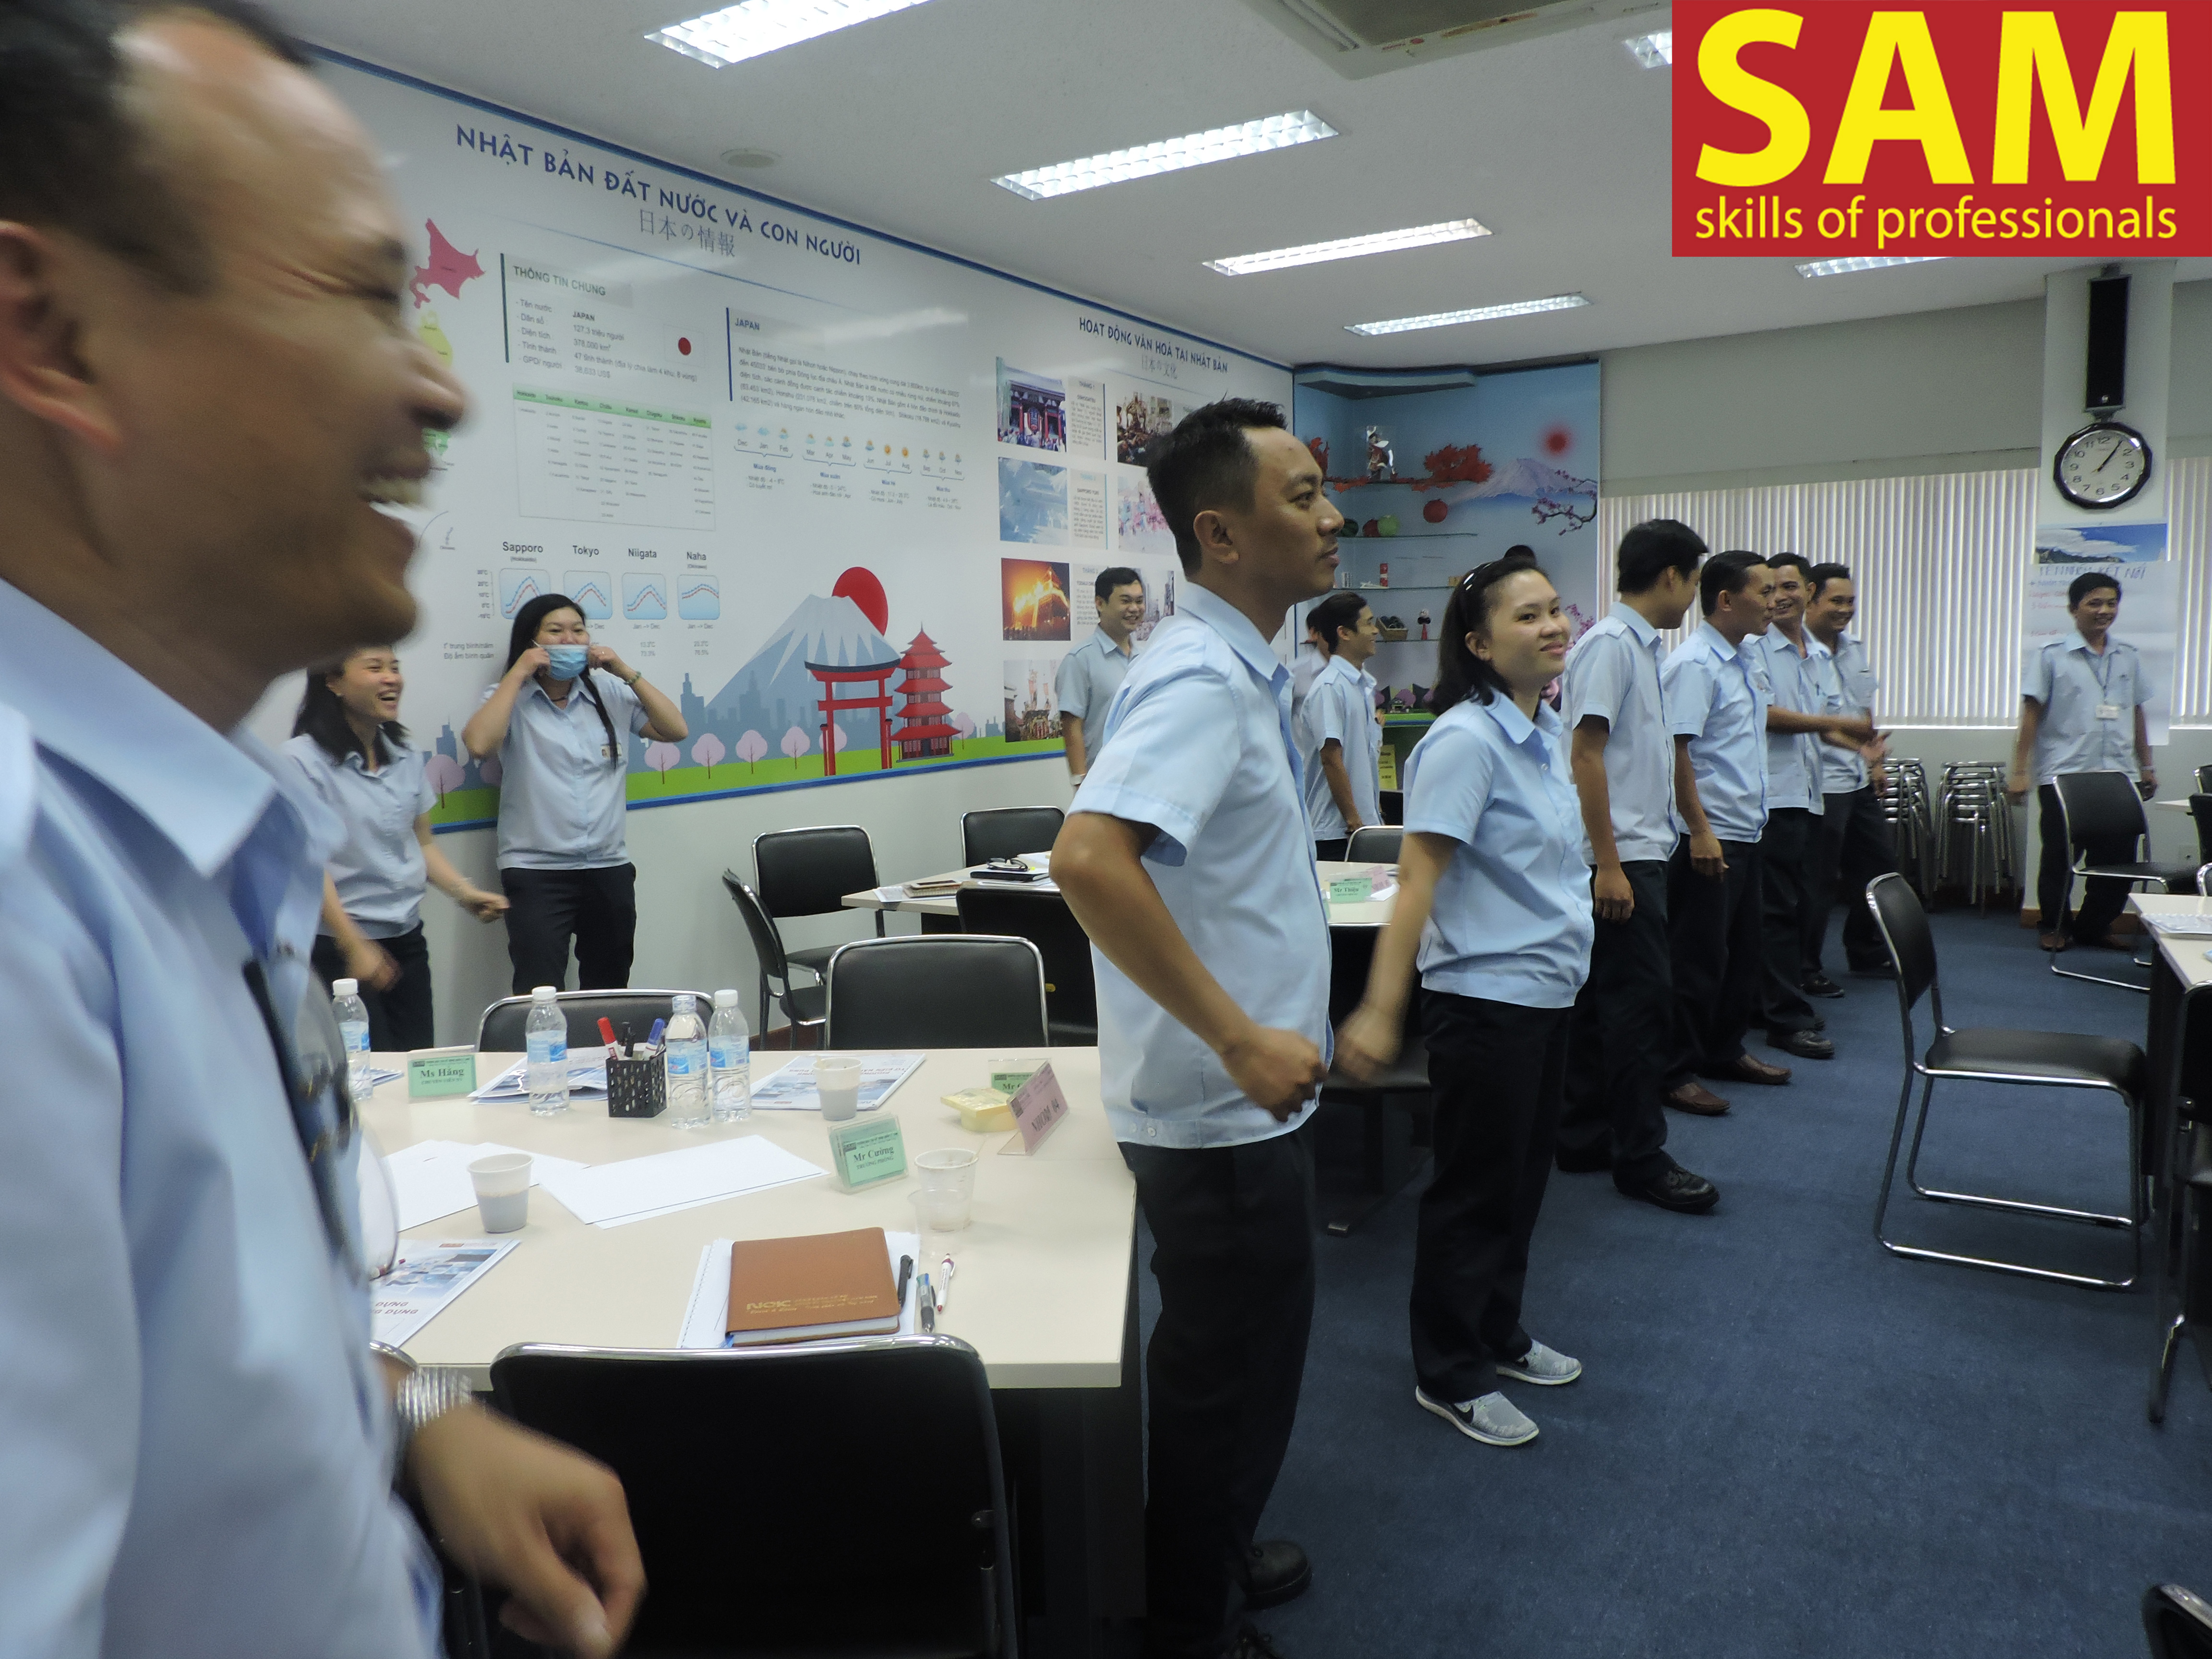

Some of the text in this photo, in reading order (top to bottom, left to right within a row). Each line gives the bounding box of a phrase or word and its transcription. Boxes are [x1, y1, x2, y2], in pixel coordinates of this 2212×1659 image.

[457, 124, 861, 265] NHẬT BẢN ĐẤT NƯỚC VÀ CON NGƯỜI
[638, 209, 737, 258] 日本の情報
[512, 265, 606, 296] THÔNG TIN CHUNG
[573, 311, 595, 321] JAPAN
[734, 318, 760, 331] JAPAN
[1079, 316, 1105, 338] HOẠT
[1107, 325, 1132, 345] ĐỘNG
[2069, 463, 2079, 471] 9
[2072, 475, 2082, 483] 8
[2082, 483, 2091, 492] 7
[2095, 487, 2104, 495] 6
[502, 541, 543, 554] Sapporo
[572, 545, 600, 557] Tokyo
[628, 548, 657, 560] Niigata
[686, 552, 707, 561] Naha
[420, 1070, 435, 1078] Ms
[854, 1146, 895, 1163] Mr Cường
